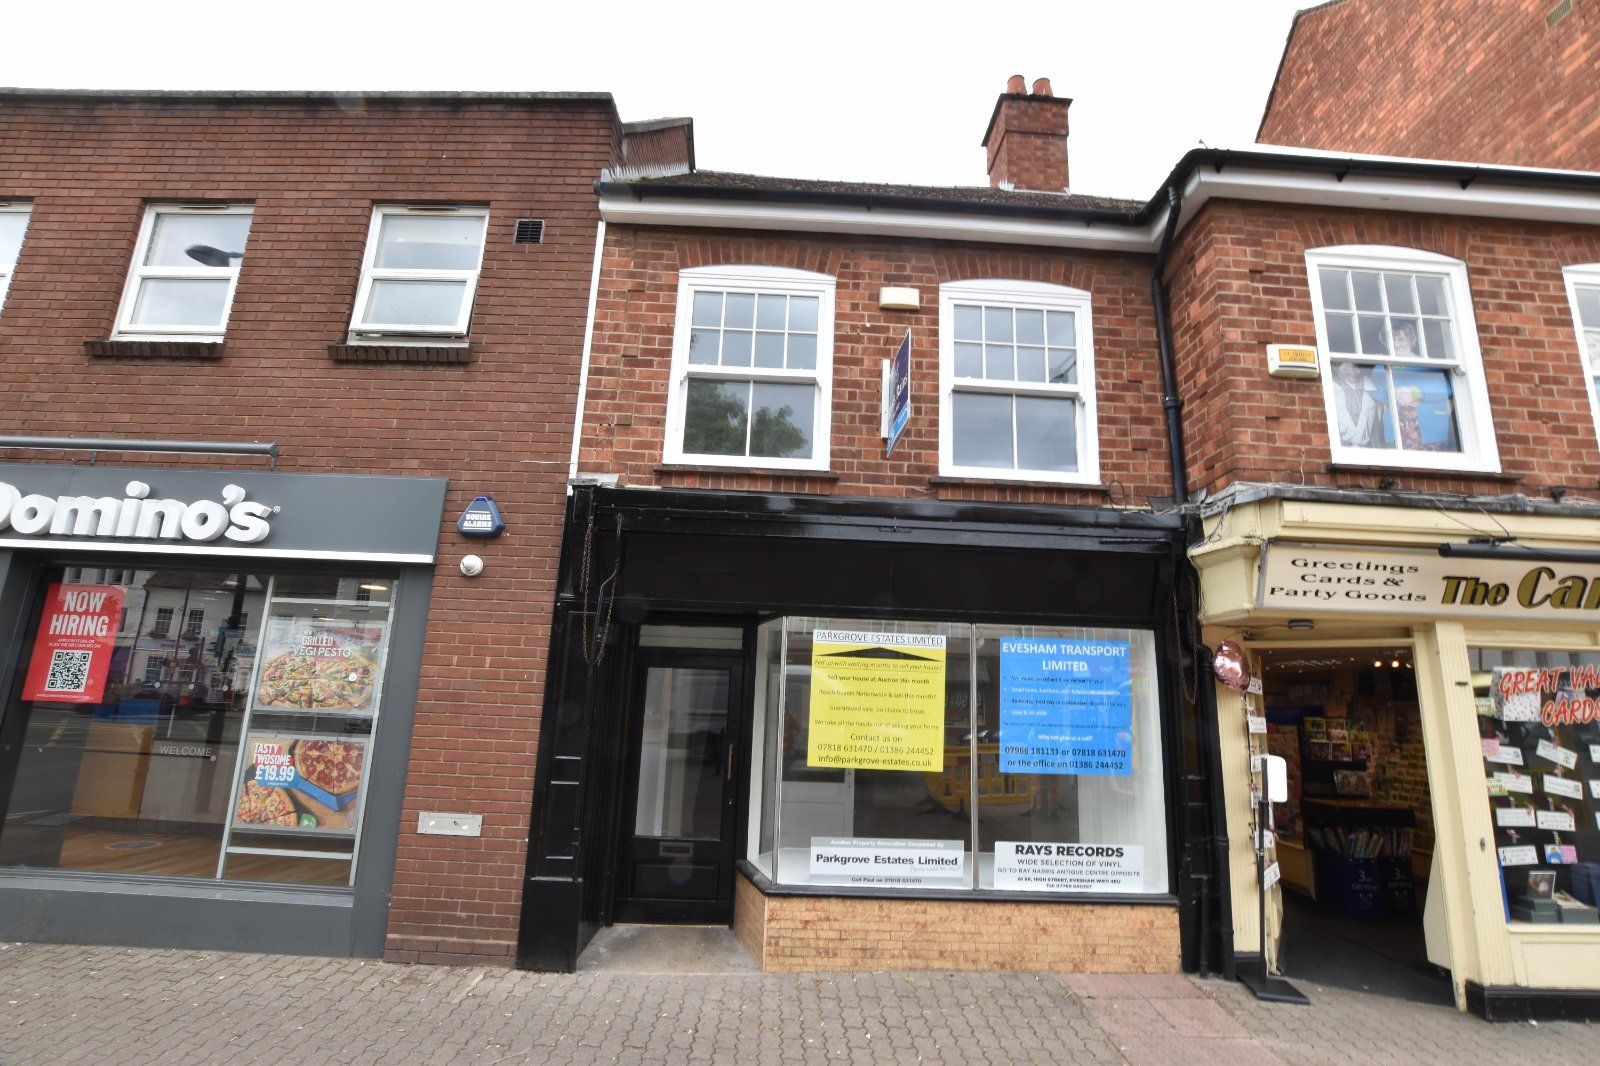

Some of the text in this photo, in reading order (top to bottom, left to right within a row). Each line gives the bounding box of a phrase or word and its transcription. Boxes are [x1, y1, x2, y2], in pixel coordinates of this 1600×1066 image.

[1291, 558, 1419, 575] Greetings
[1300, 574, 1404, 587] Cards &
[1269, 587, 1427, 602] Party Goods
[1441, 576, 1510, 606] The
[63, 590, 107, 612] NOW
[48, 614, 109, 636] HIRING
[302, 636, 333, 646] GRILLED
[816, 631, 944, 646] PARKGROVE ESTATES LIMITED
[294, 646, 351, 657] VEGI PESTO
[1002, 642, 1126, 656] EVESHAM TRANSPORT
[1042, 660, 1088, 672] LIMITED
[1499, 667, 1568, 702] GREAT
[160, 745, 213, 757] WELCOME
[254, 743, 280, 754] TASTY
[252, 754, 291, 765] TWOSOME
[255, 765, 295, 781] £19.99
[1015, 844, 1124, 858] RAYS RECORDS
[816, 854, 958, 866] Parkgrove Estates Limited
